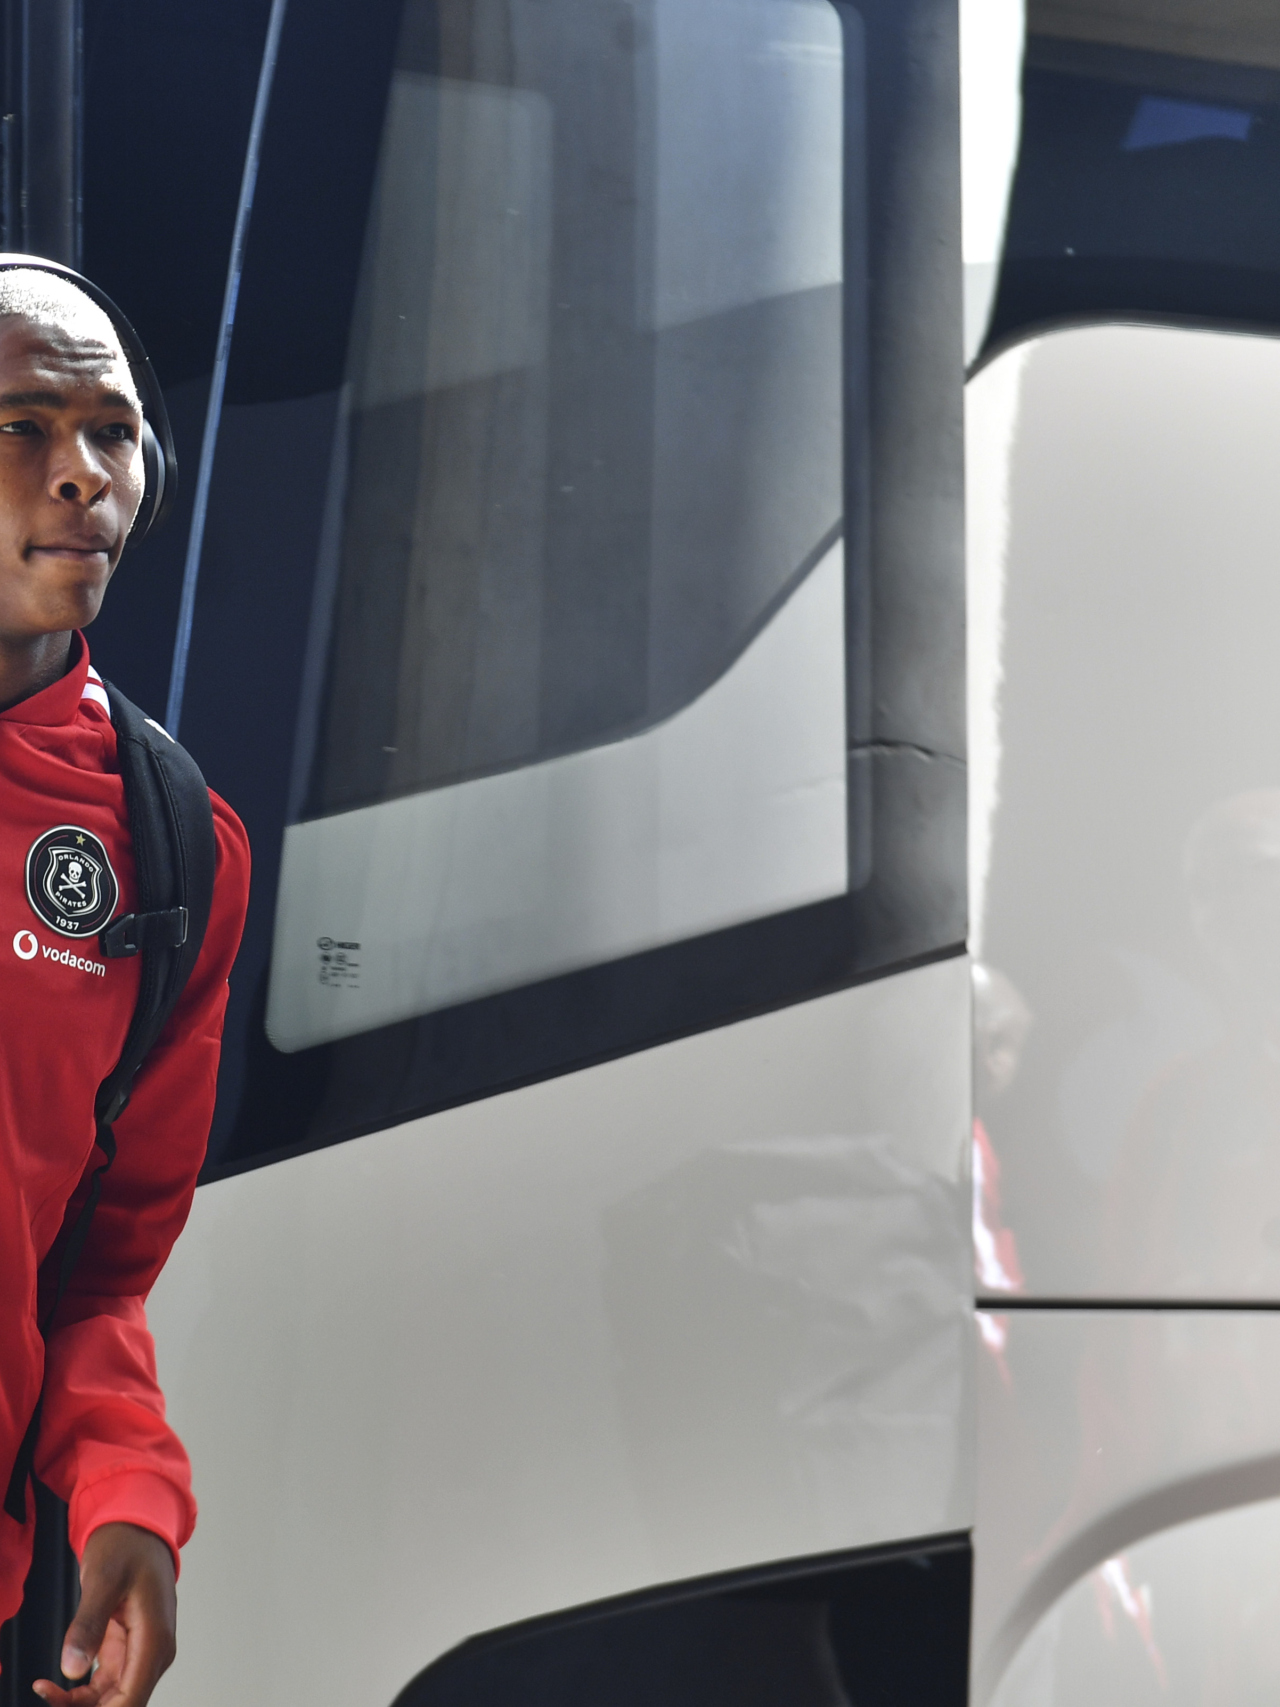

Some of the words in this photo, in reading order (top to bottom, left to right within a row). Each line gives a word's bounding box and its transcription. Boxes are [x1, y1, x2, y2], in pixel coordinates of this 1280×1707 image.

[58, 854, 94, 873] ORLANDO
[55, 891, 87, 908] PIRATES
[55, 915, 79, 931] 1937
[42, 945, 106, 977] vodacom
